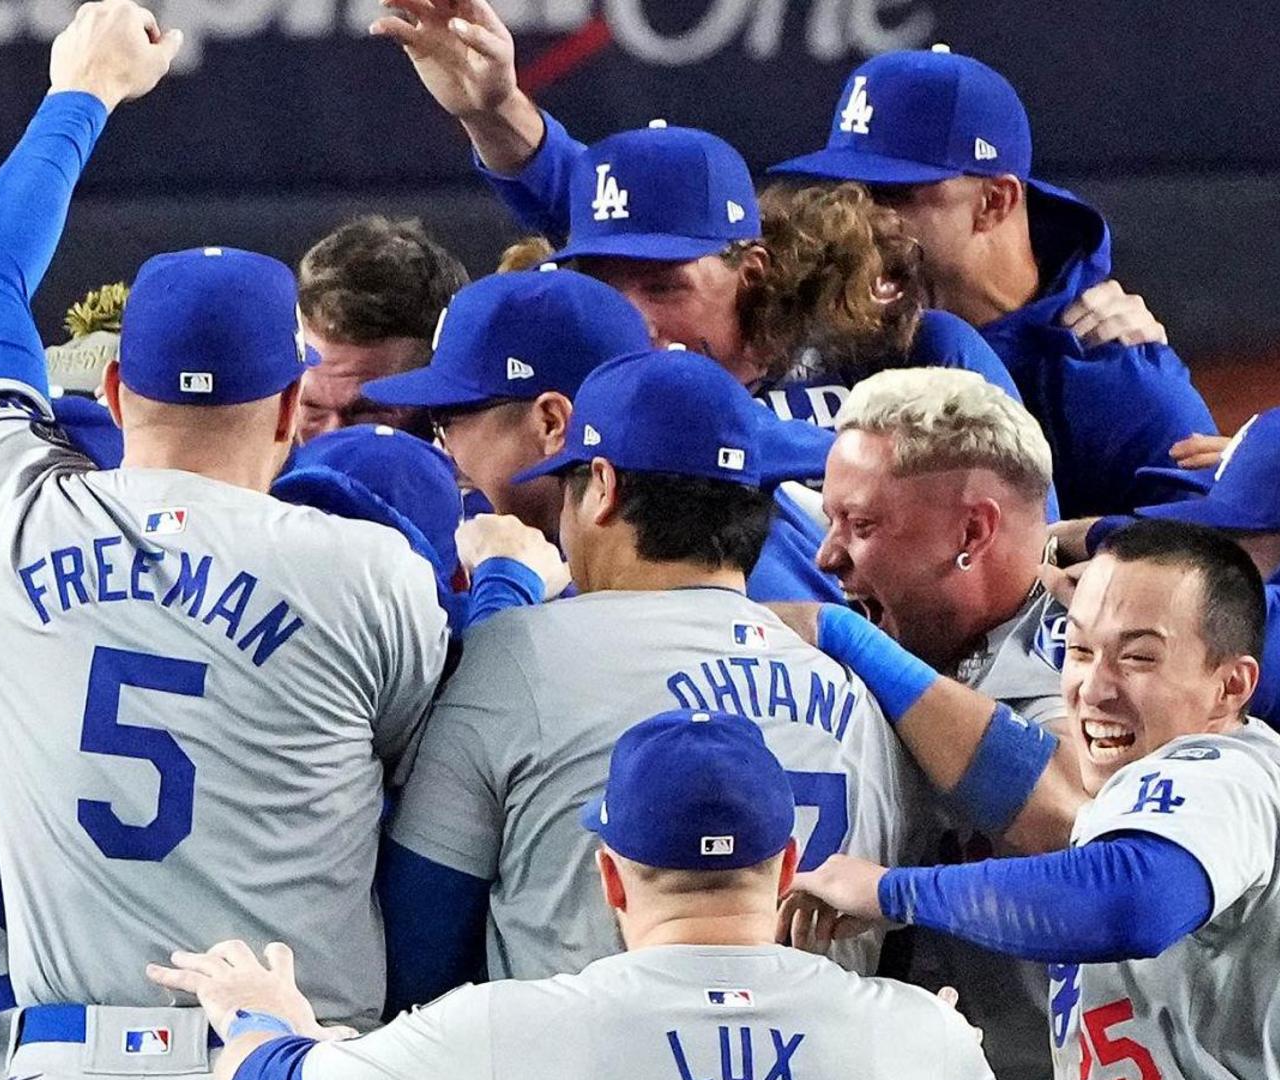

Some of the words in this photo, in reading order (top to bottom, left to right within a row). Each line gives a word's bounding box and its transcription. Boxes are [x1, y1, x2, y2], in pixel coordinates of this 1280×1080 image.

[840, 76, 873, 134] LA
[591, 164, 629, 220] LA
[20, 536, 306, 668] FREEMAN
[666, 657, 856, 743] OHTANI
[77, 646, 208, 862] 5
[1122, 771, 1186, 814] LA
[783, 770, 850, 873] 7
